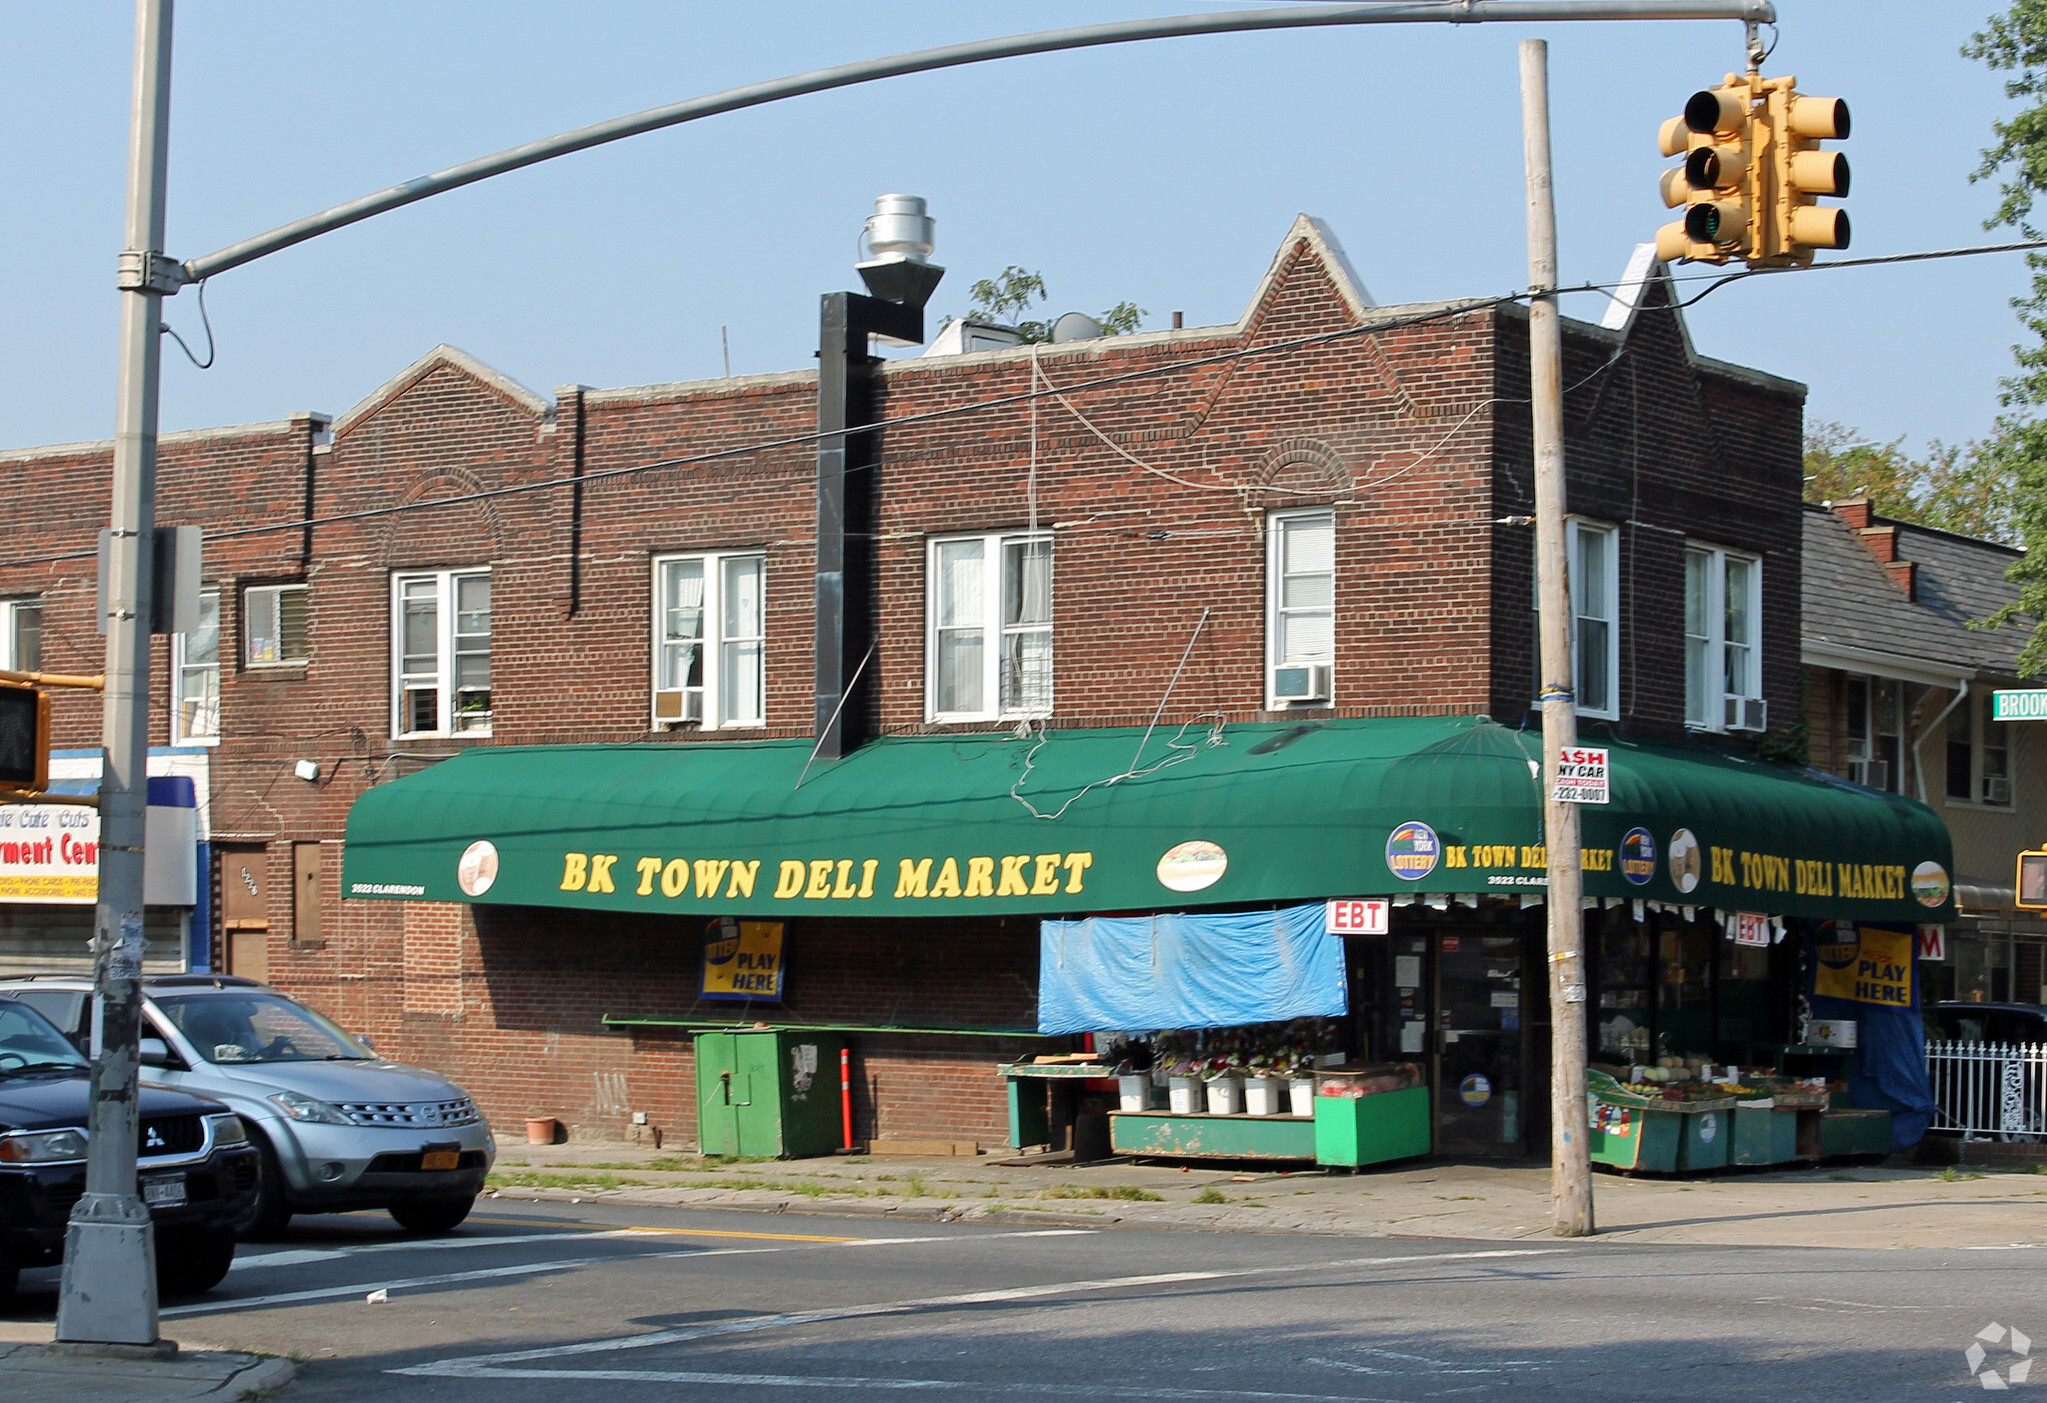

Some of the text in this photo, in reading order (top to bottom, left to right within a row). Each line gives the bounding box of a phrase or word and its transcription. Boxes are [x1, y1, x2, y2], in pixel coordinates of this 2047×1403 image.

[1578, 766, 1605, 777] CAR
[1390, 855, 1436, 870] LOTTERY
[1445, 845, 1468, 868] BK
[1472, 845, 1517, 869] TOWN
[559, 851, 1093, 899] BK TOWN DELI MARKET
[1710, 846, 1906, 899] BK TOWN DELI MARKET
[1335, 901, 1381, 929] EBT
[1739, 914, 1765, 941] EBT
[738, 952, 777, 971] PLAY
[1857, 960, 1907, 983] PLAY
[732, 973, 775, 992] HERE
[1855, 980, 1907, 1004] HERE
